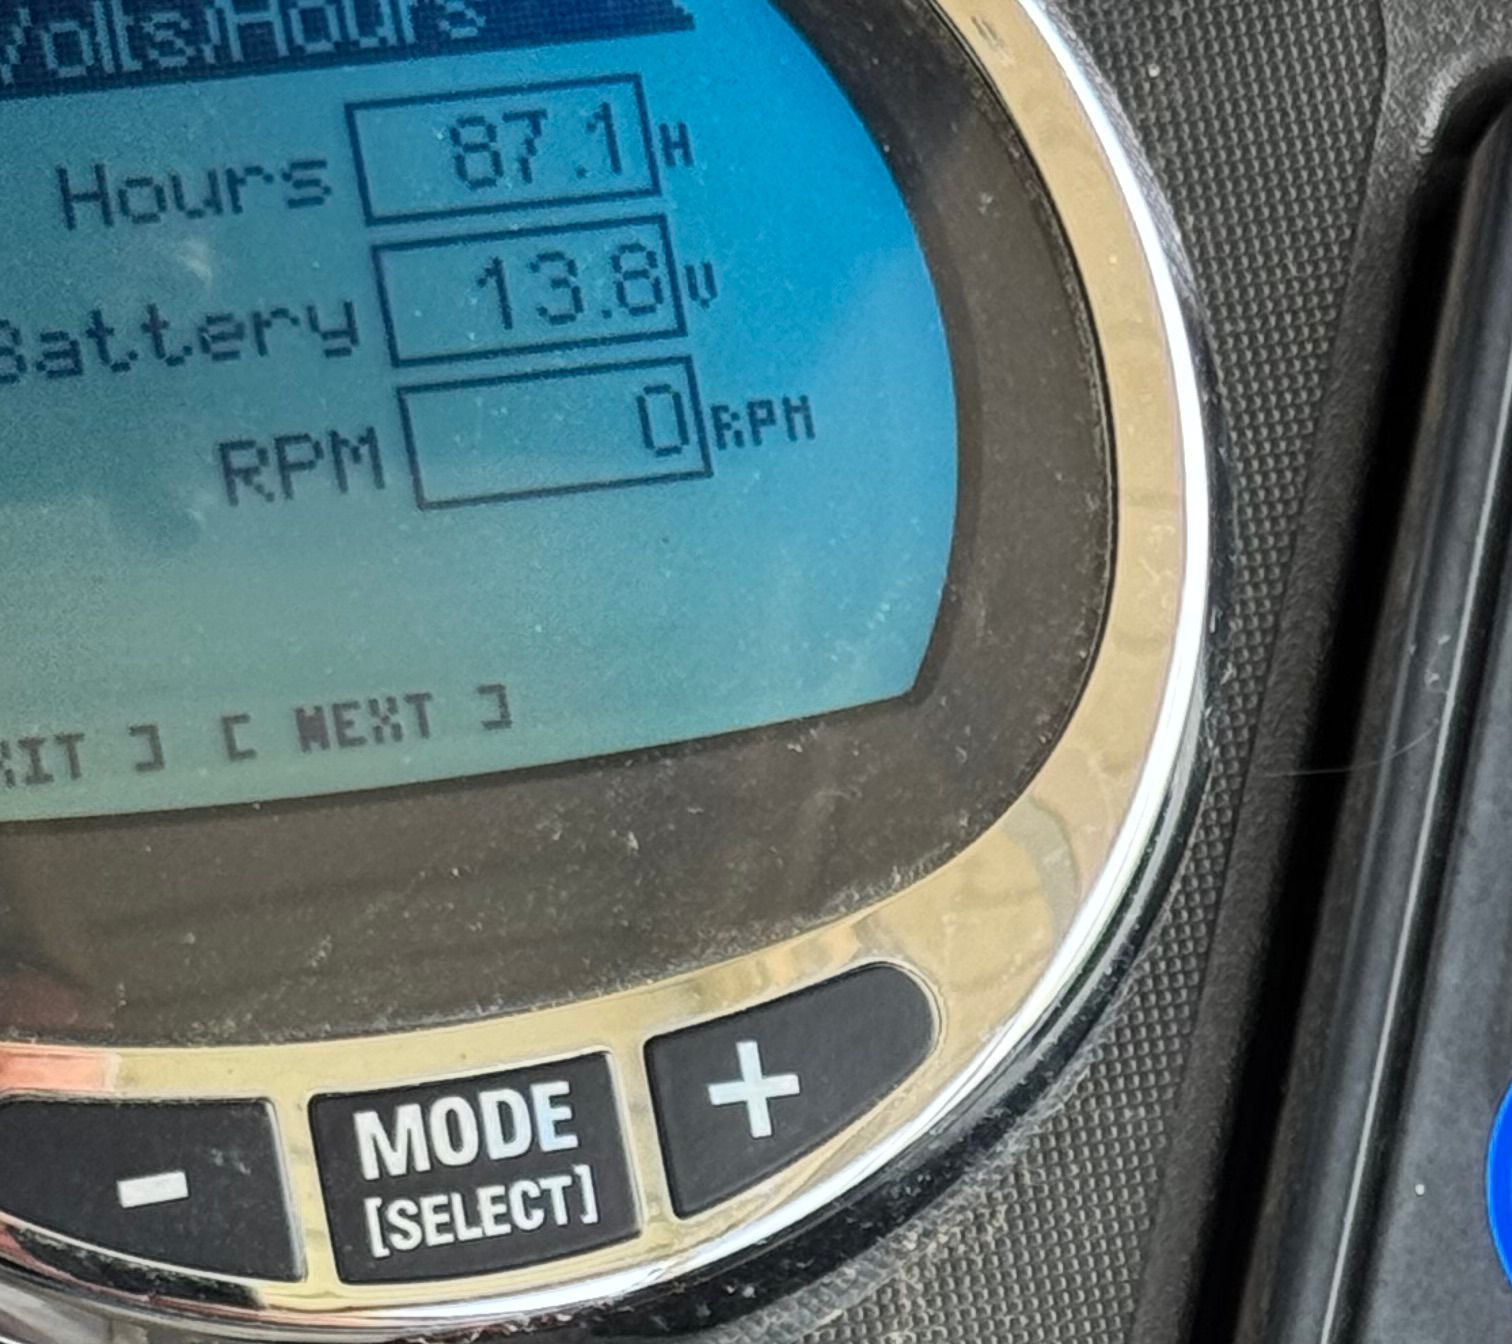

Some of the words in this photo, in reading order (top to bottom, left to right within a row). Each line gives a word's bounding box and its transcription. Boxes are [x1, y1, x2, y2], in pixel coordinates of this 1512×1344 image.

[54, 158, 332, 230] Hours
[446, 101, 626, 190] 87.1
[661, 123, 693, 167] H
[0, 300, 361, 385] Battery
[476, 242, 664, 330] 13.8
[218, 425, 387, 506] RPM
[638, 384, 690, 456] 0
[713, 395, 816, 450] RPM
[294, 692, 433, 753] NEXT
[354, 1080, 580, 1181] MODE
